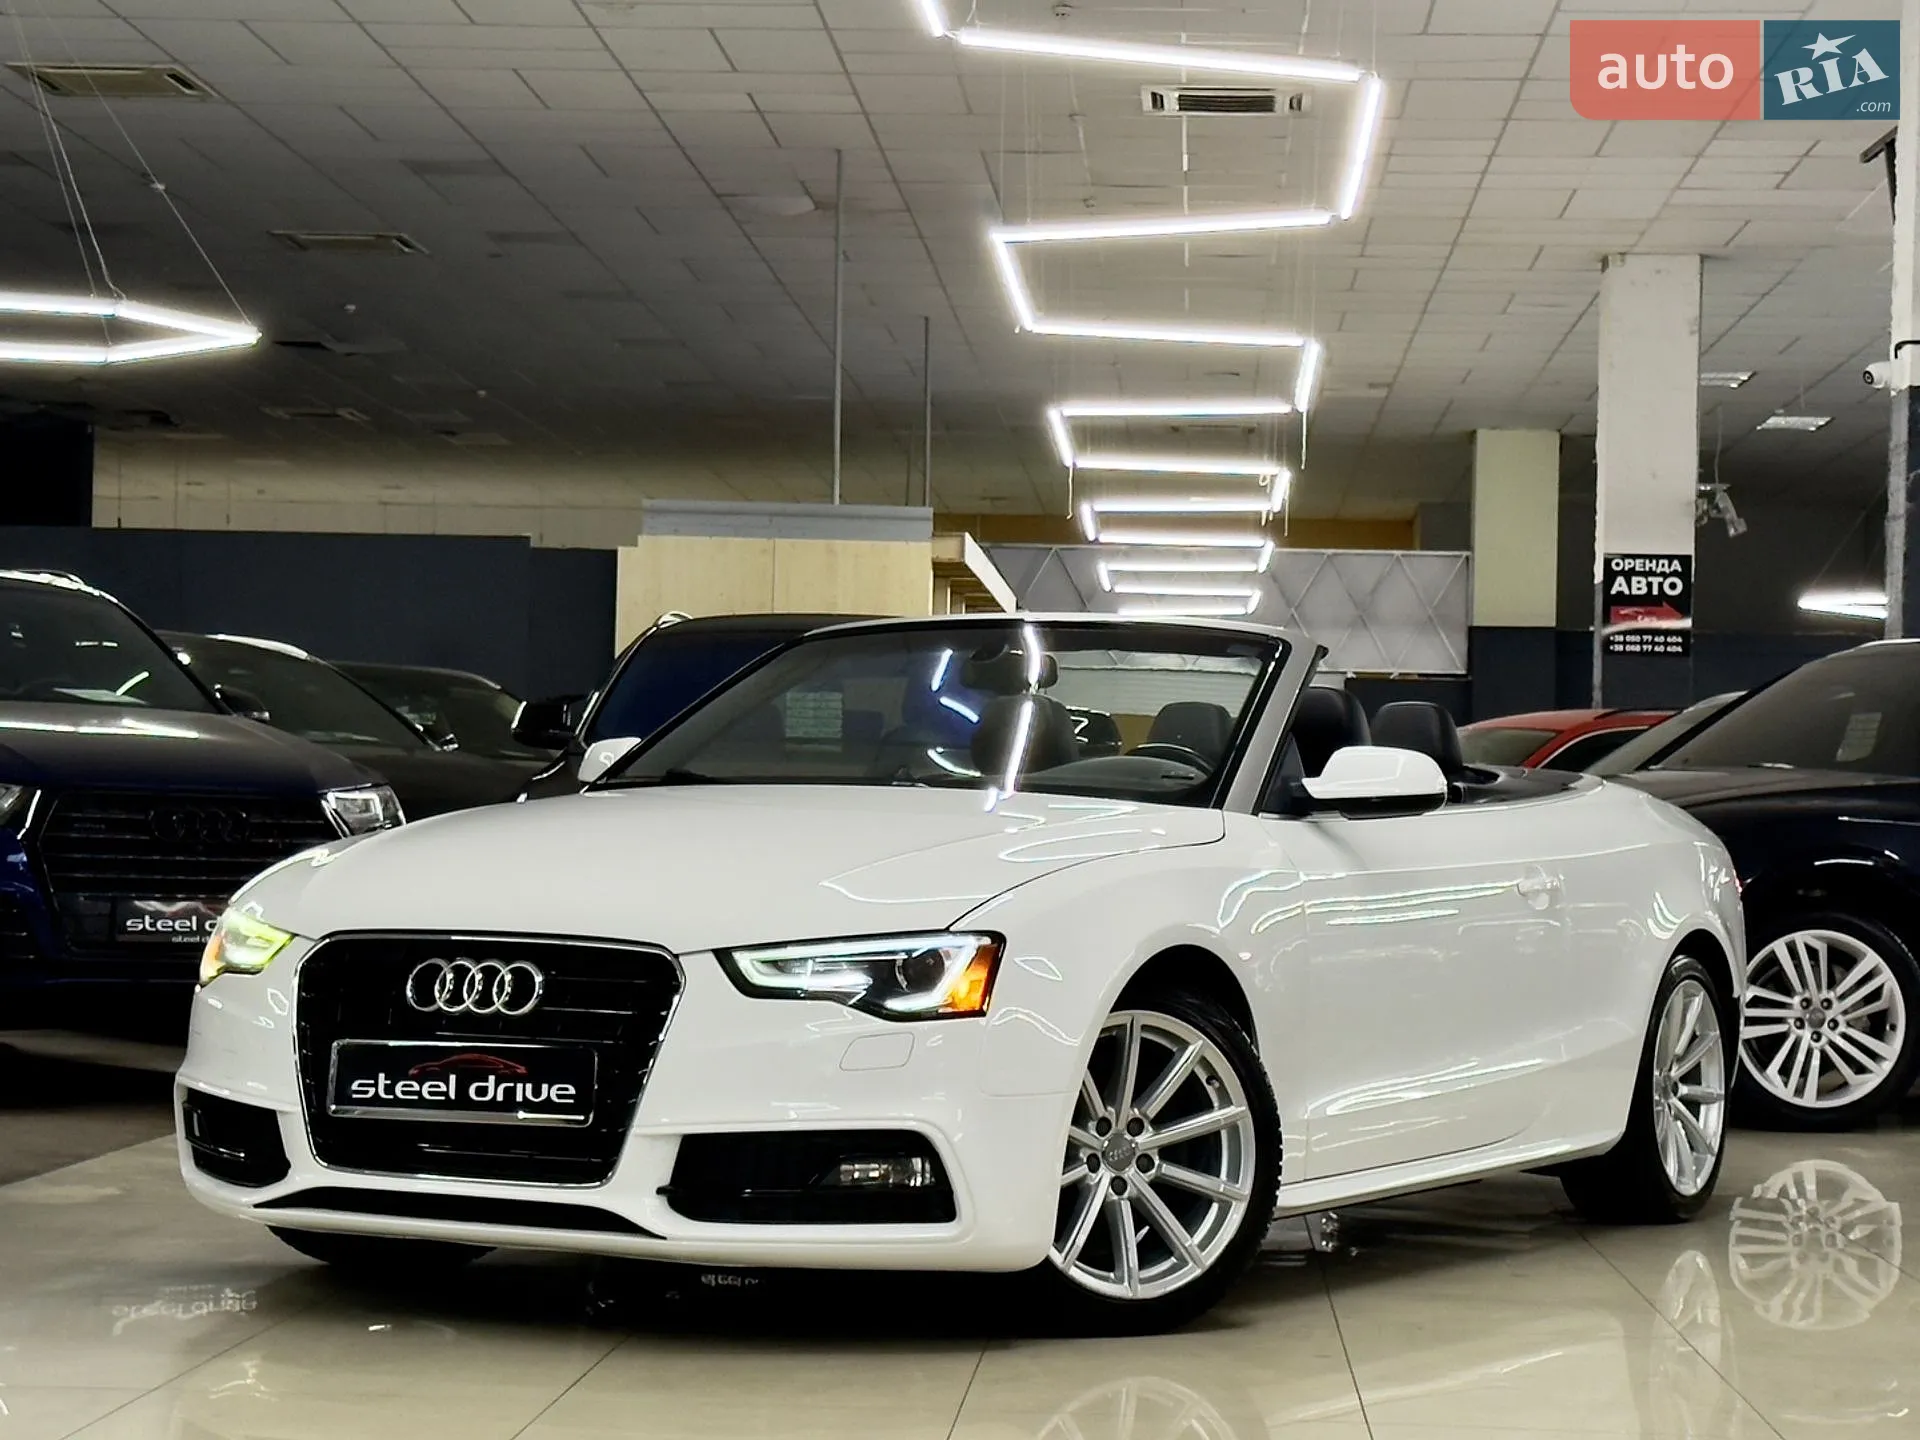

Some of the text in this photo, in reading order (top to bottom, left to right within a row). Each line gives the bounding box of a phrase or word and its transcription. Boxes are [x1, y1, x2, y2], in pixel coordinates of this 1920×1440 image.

[1611, 558, 1682, 573] ОРЕНДА
[1610, 576, 1683, 596] АВТО
[1642, 635, 1653, 643] 77
[1642, 644, 1653, 652] 77
[126, 915, 197, 932] steel
[350, 1072, 576, 1103] steel drive
